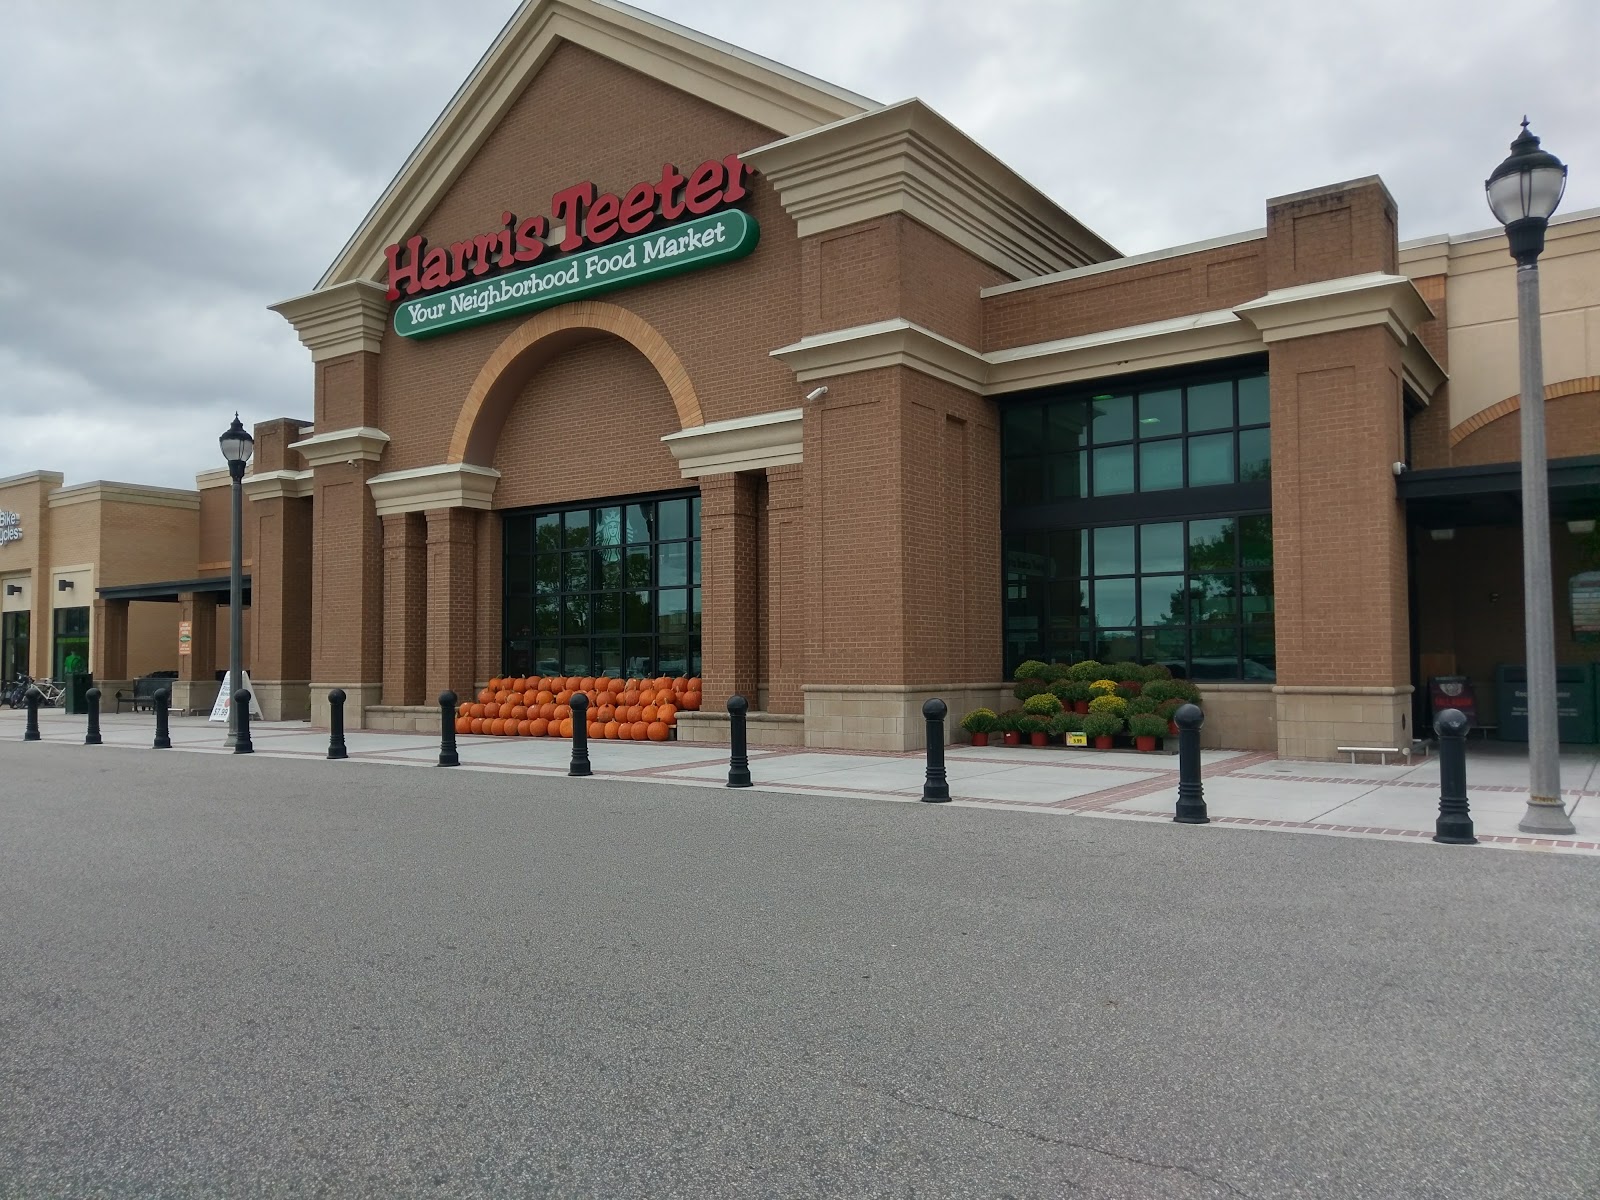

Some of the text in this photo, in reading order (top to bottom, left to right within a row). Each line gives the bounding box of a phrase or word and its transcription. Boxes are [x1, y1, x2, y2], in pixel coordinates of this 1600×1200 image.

[384, 153, 756, 301] Harris Teeter
[407, 221, 726, 326] Your Neighborhood Food Market
[0, 511, 17, 526] Bike
[213, 708, 228, 716] $7.99
